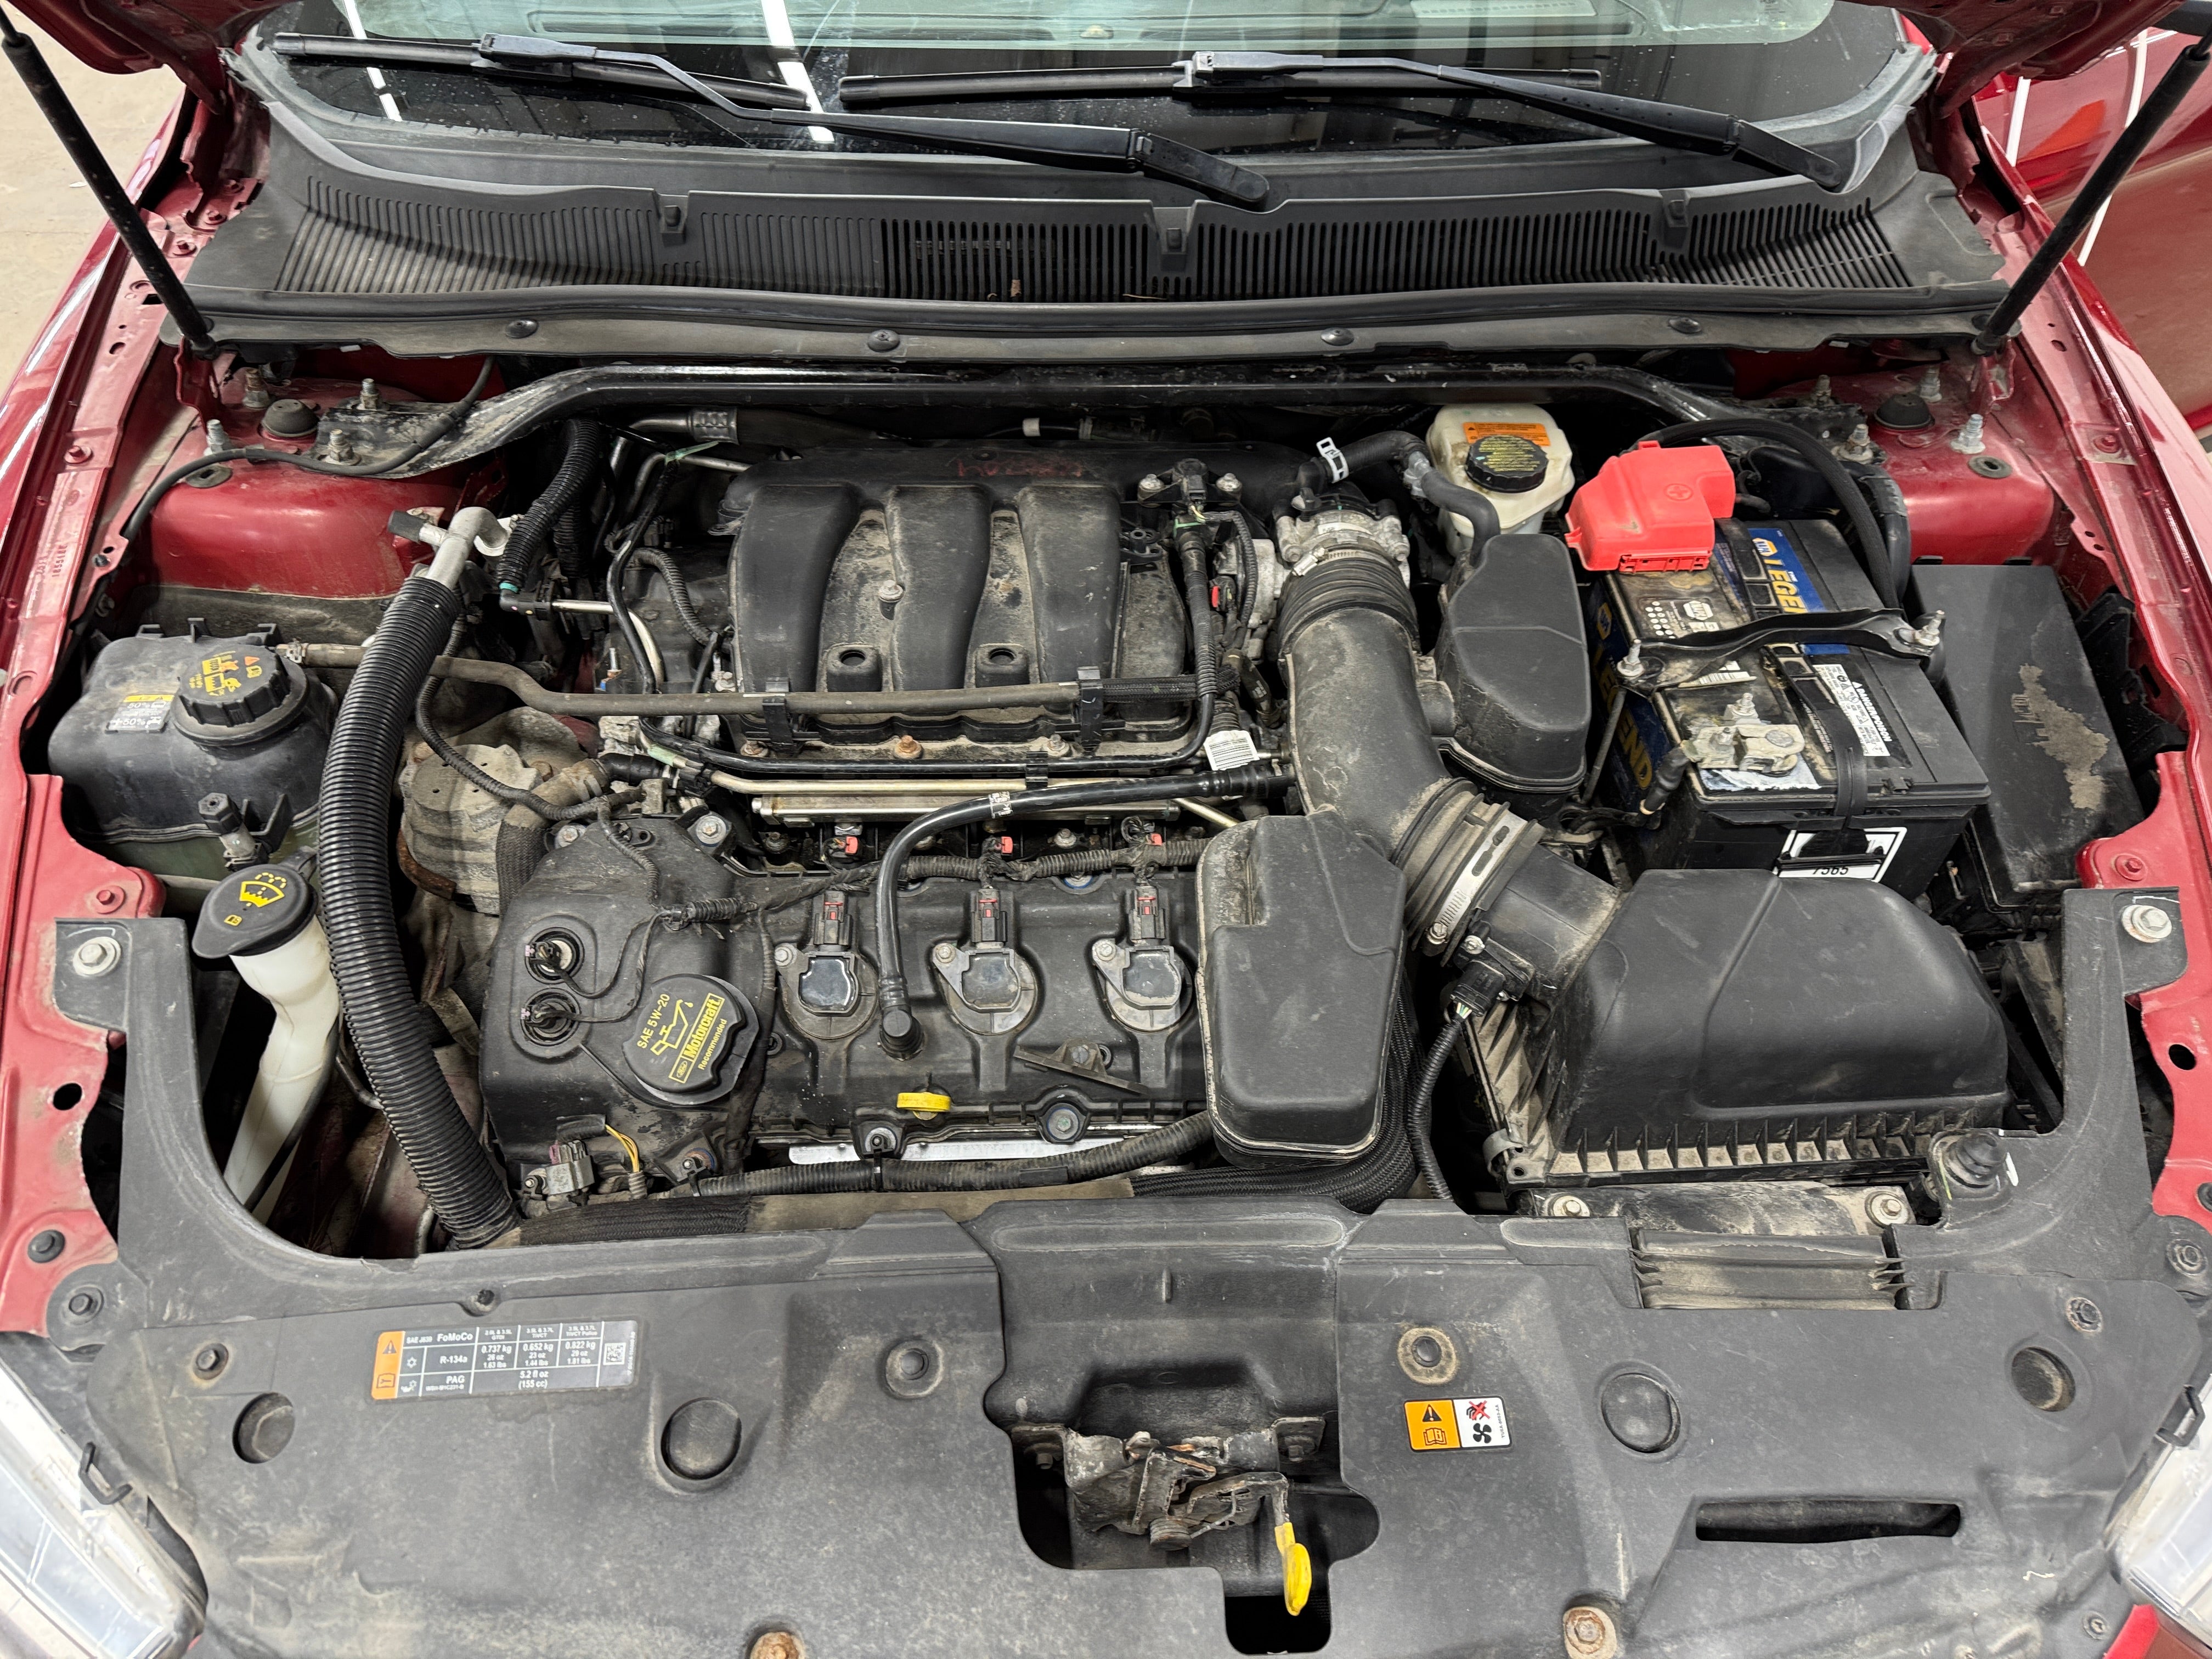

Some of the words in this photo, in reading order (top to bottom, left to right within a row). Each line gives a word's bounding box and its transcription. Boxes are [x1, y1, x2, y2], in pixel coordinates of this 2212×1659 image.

[1856, 688, 1893, 742] DANGER/POISON
[637, 1028, 654, 1049] SAE
[647, 994, 670, 1027] 5W-20
[684, 998, 720, 1058] Motorcraft
[698, 1018, 727, 1070] Recommended
[437, 1332, 473, 1342] FoMoCo
[481, 1345, 501, 1354] 0.737
[501, 1345, 512, 1354] kg
[522, 1342, 543, 1351] 0.652
[544, 1342, 554, 1352] kg
[565, 1341, 585, 1350] 0.822
[586, 1340, 596, 1350] kg
[439, 1355, 468, 1364] R-134a
[445, 1375, 465, 1384] PAG
[520, 1370, 532, 1379] 5.2
[518, 1380, 535, 1390] (155
[535, 1379, 548, 1389] cc)
